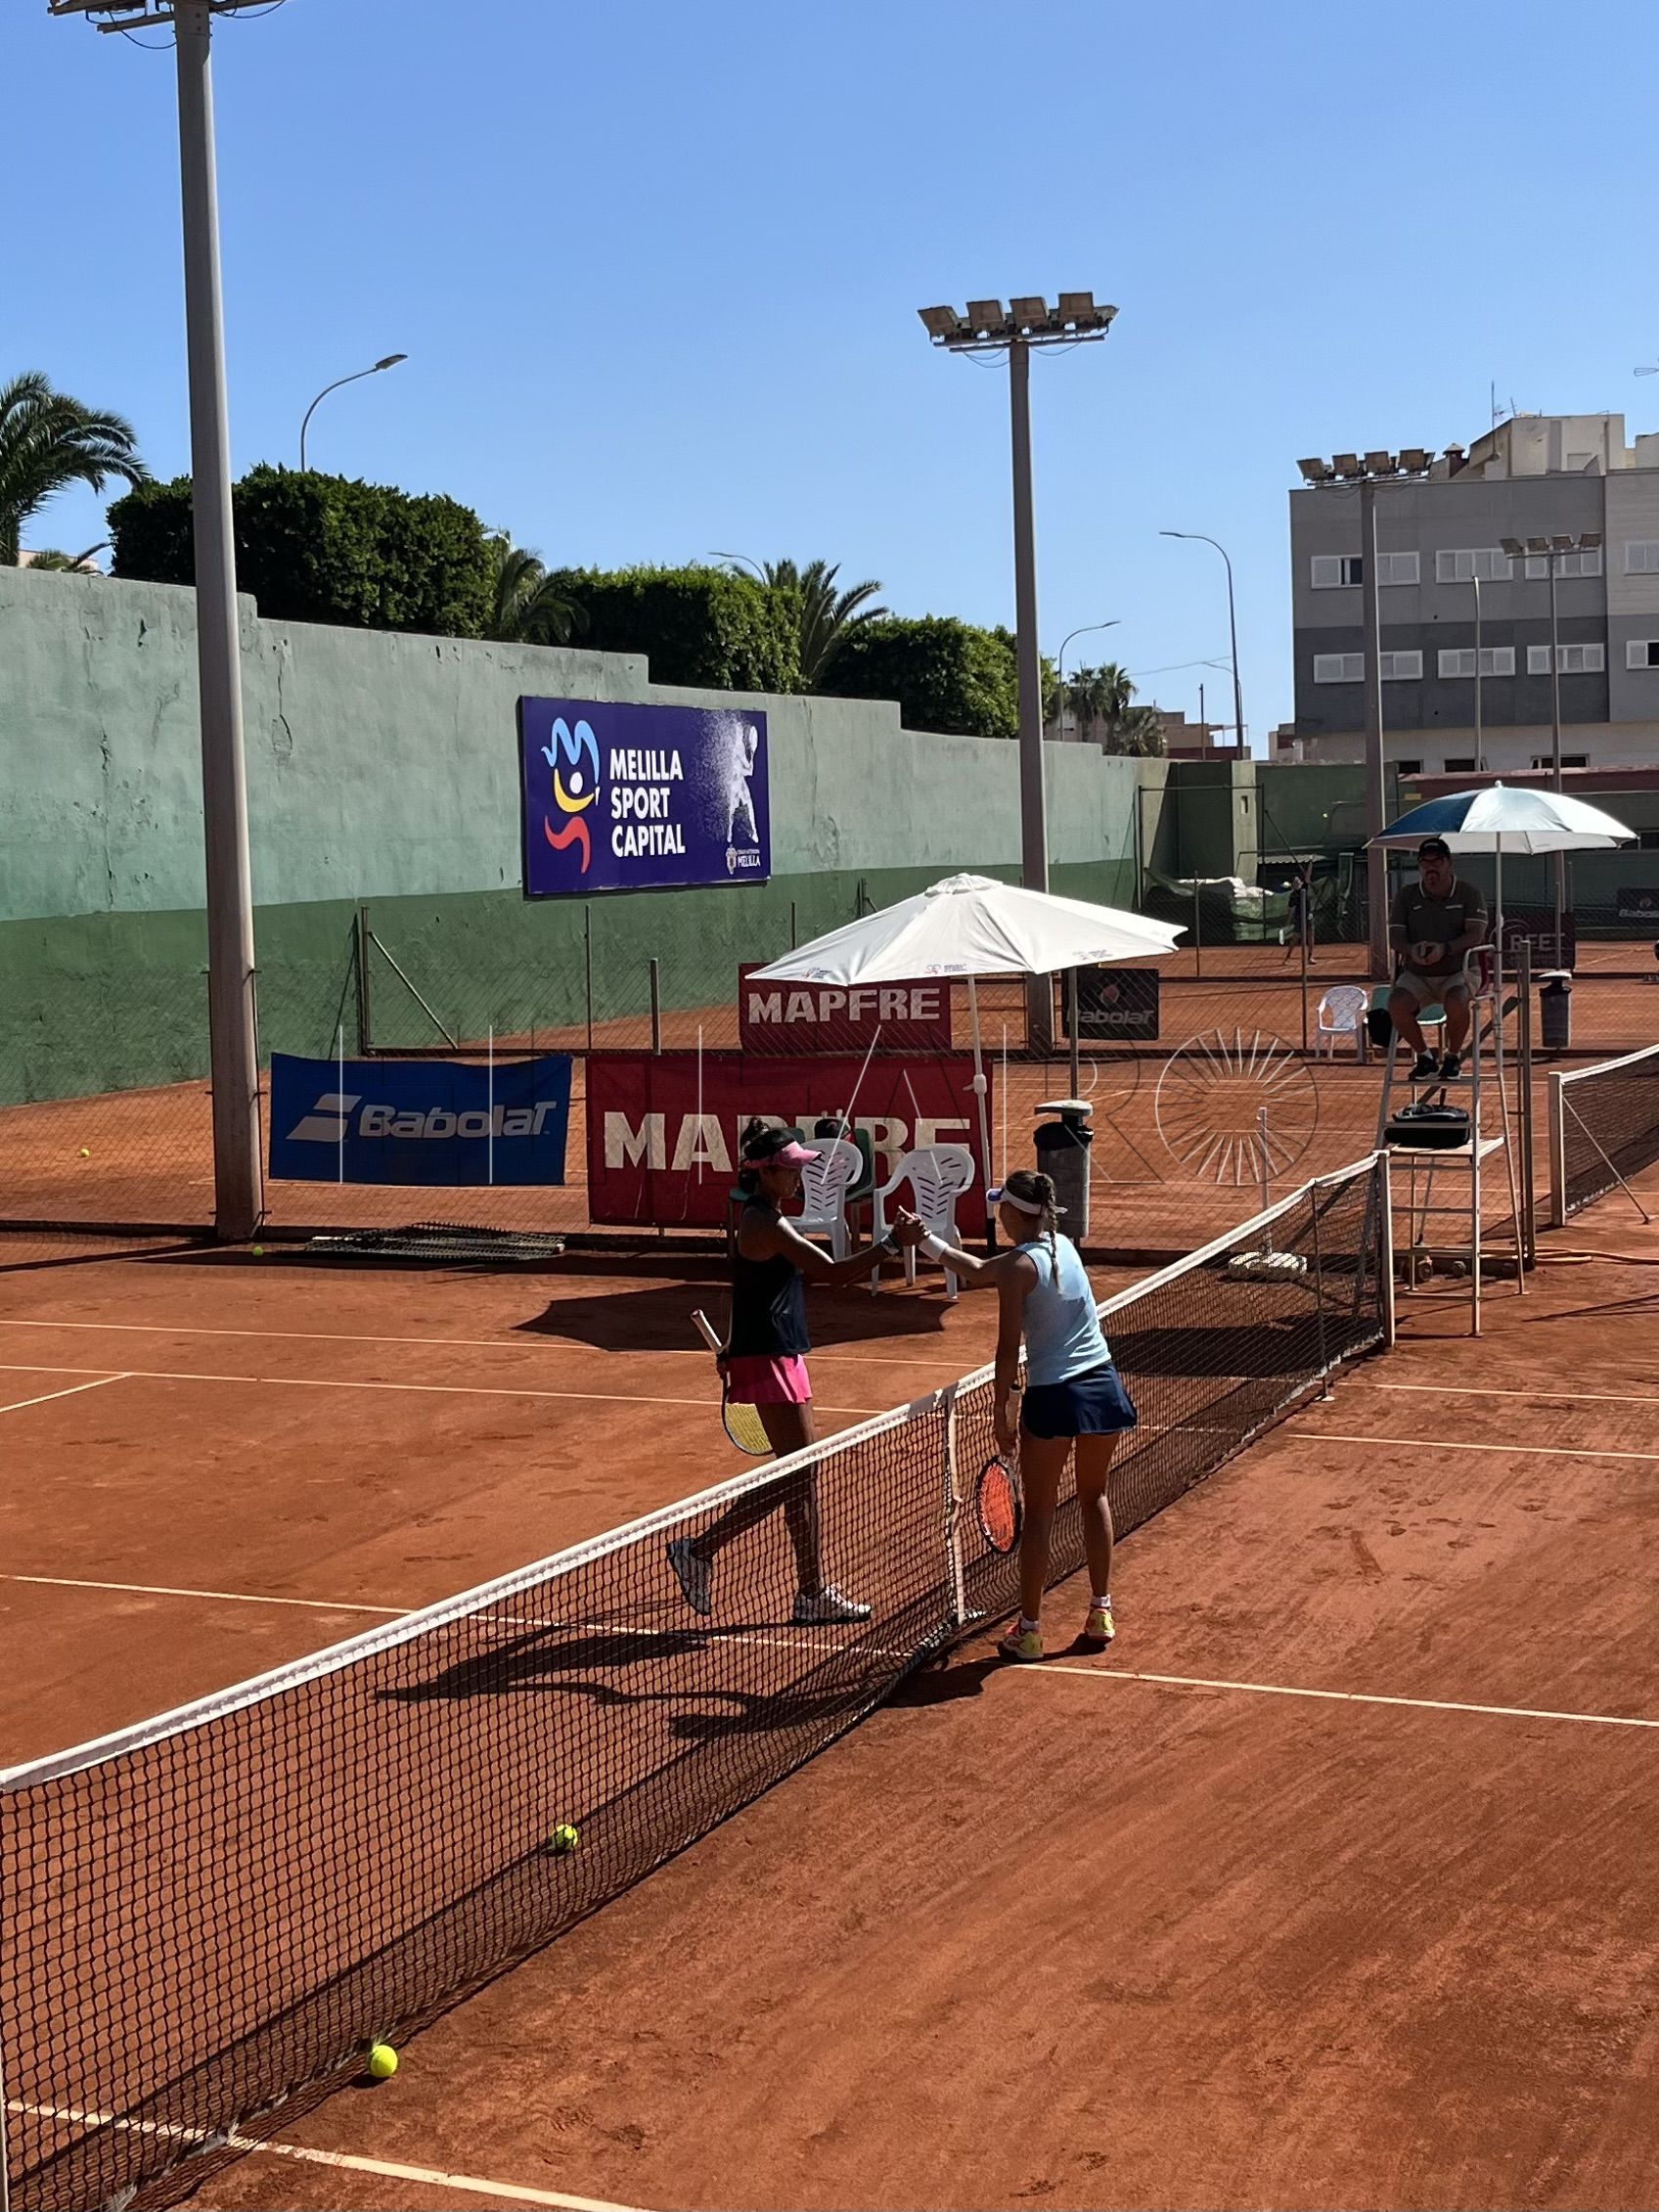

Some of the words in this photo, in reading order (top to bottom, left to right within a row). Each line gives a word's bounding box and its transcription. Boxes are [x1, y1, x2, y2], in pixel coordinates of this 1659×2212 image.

[609, 748, 684, 781] MELILLA
[610, 787, 671, 820] SPORT
[611, 824, 687, 858] CAPITAL
[737, 854, 761, 868] MELILLA
[747, 988, 940, 1024] MAPFRE
